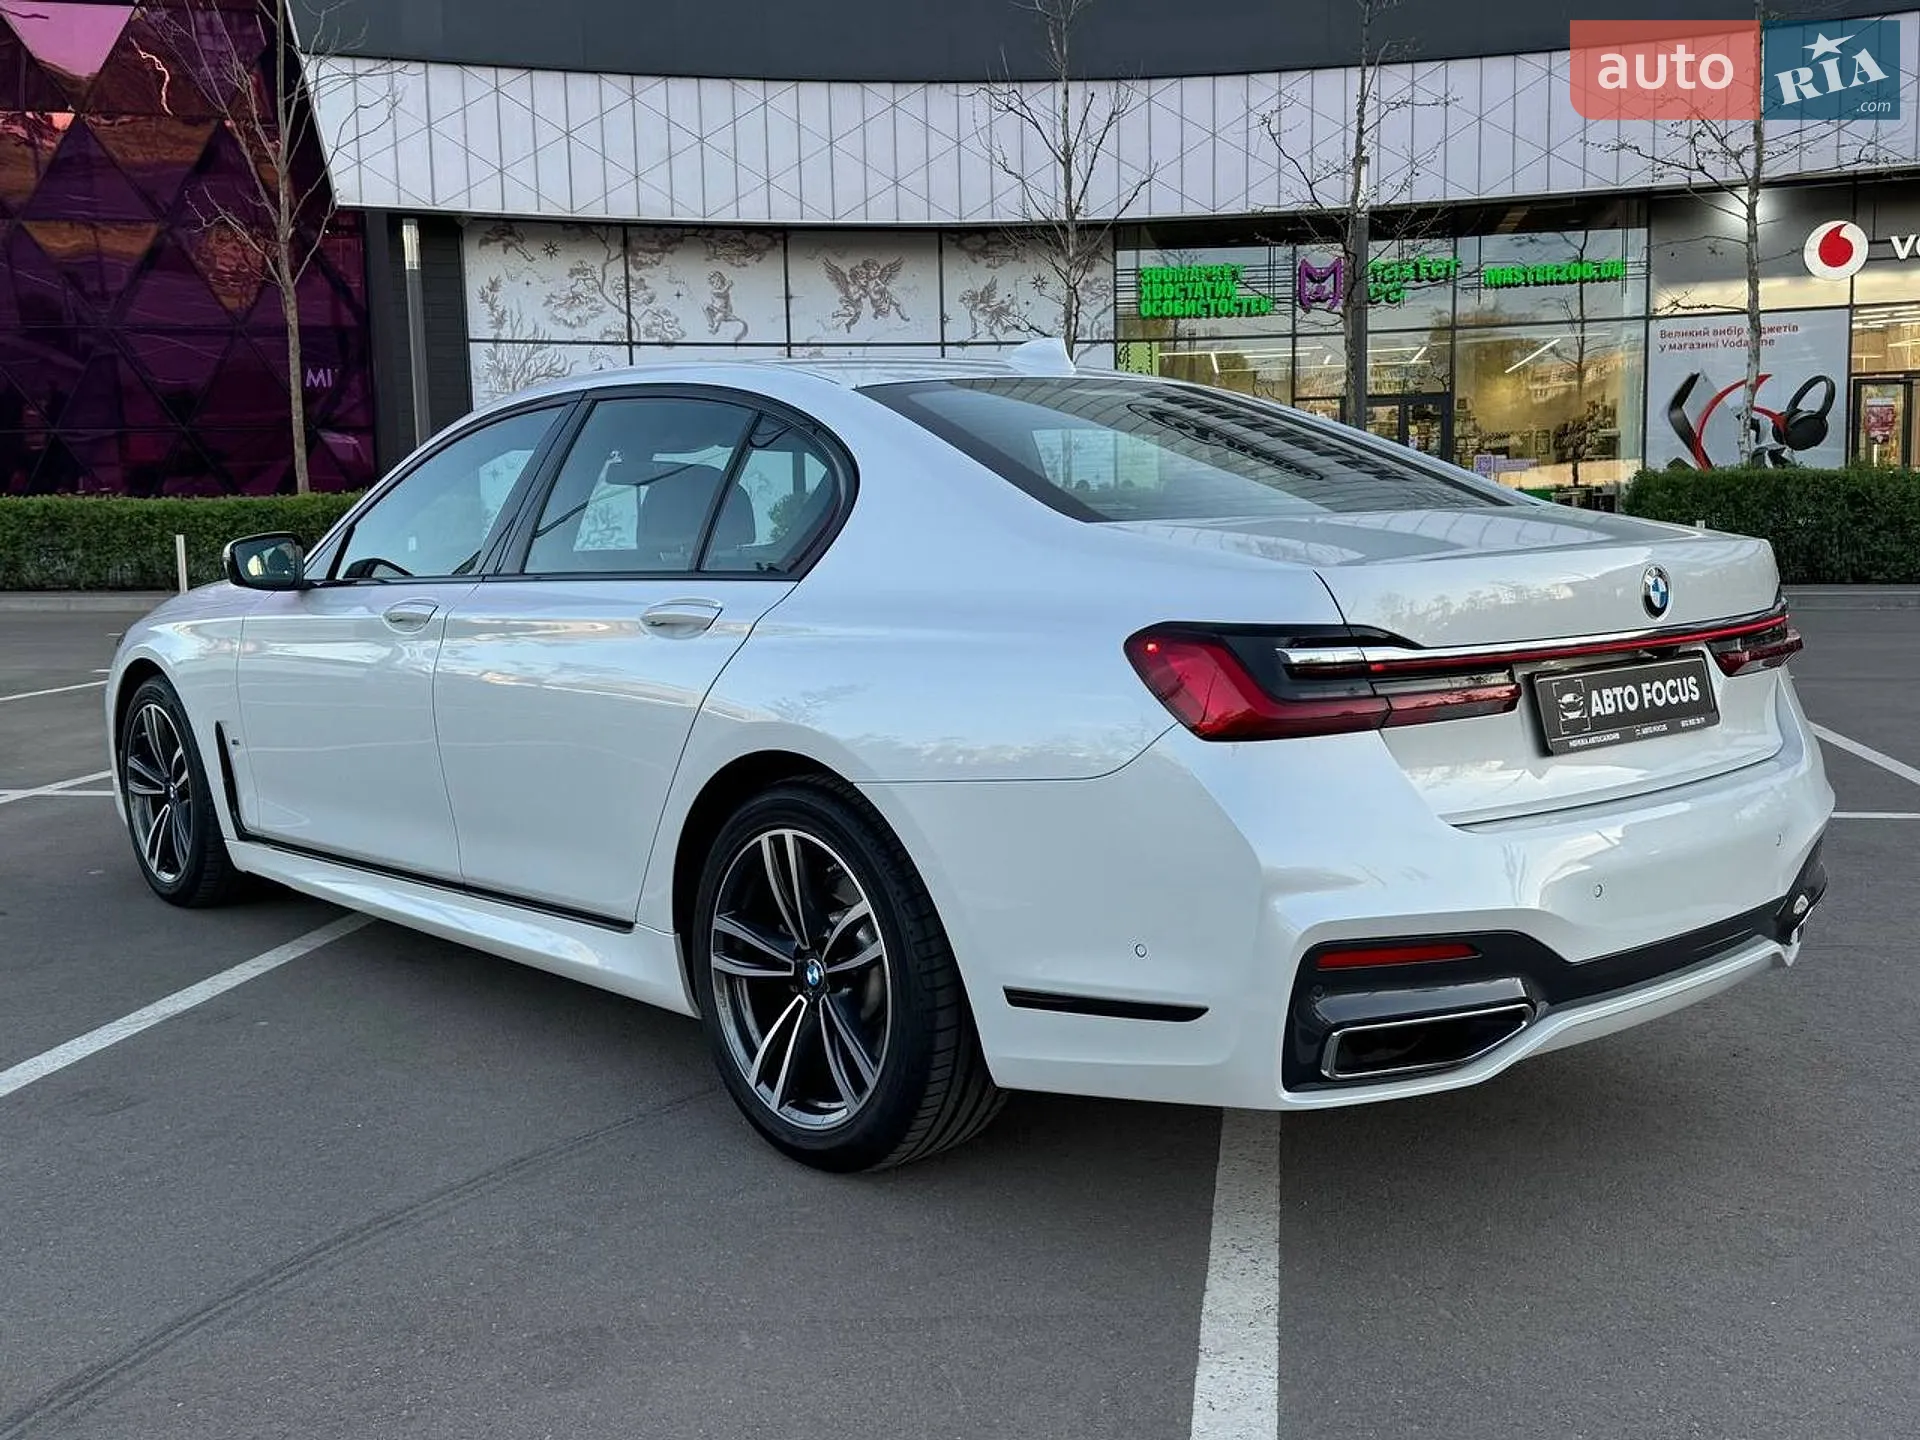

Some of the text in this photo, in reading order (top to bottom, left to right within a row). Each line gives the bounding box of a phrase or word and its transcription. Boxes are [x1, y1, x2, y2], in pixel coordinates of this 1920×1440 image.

[1660, 328, 1710, 339] Великий
[1712, 325, 1745, 337] вибір
[1668, 341, 1719, 351] магазині
[1722, 338, 1776, 349] Vodane
[1641, 676, 1700, 709] FOCUS
